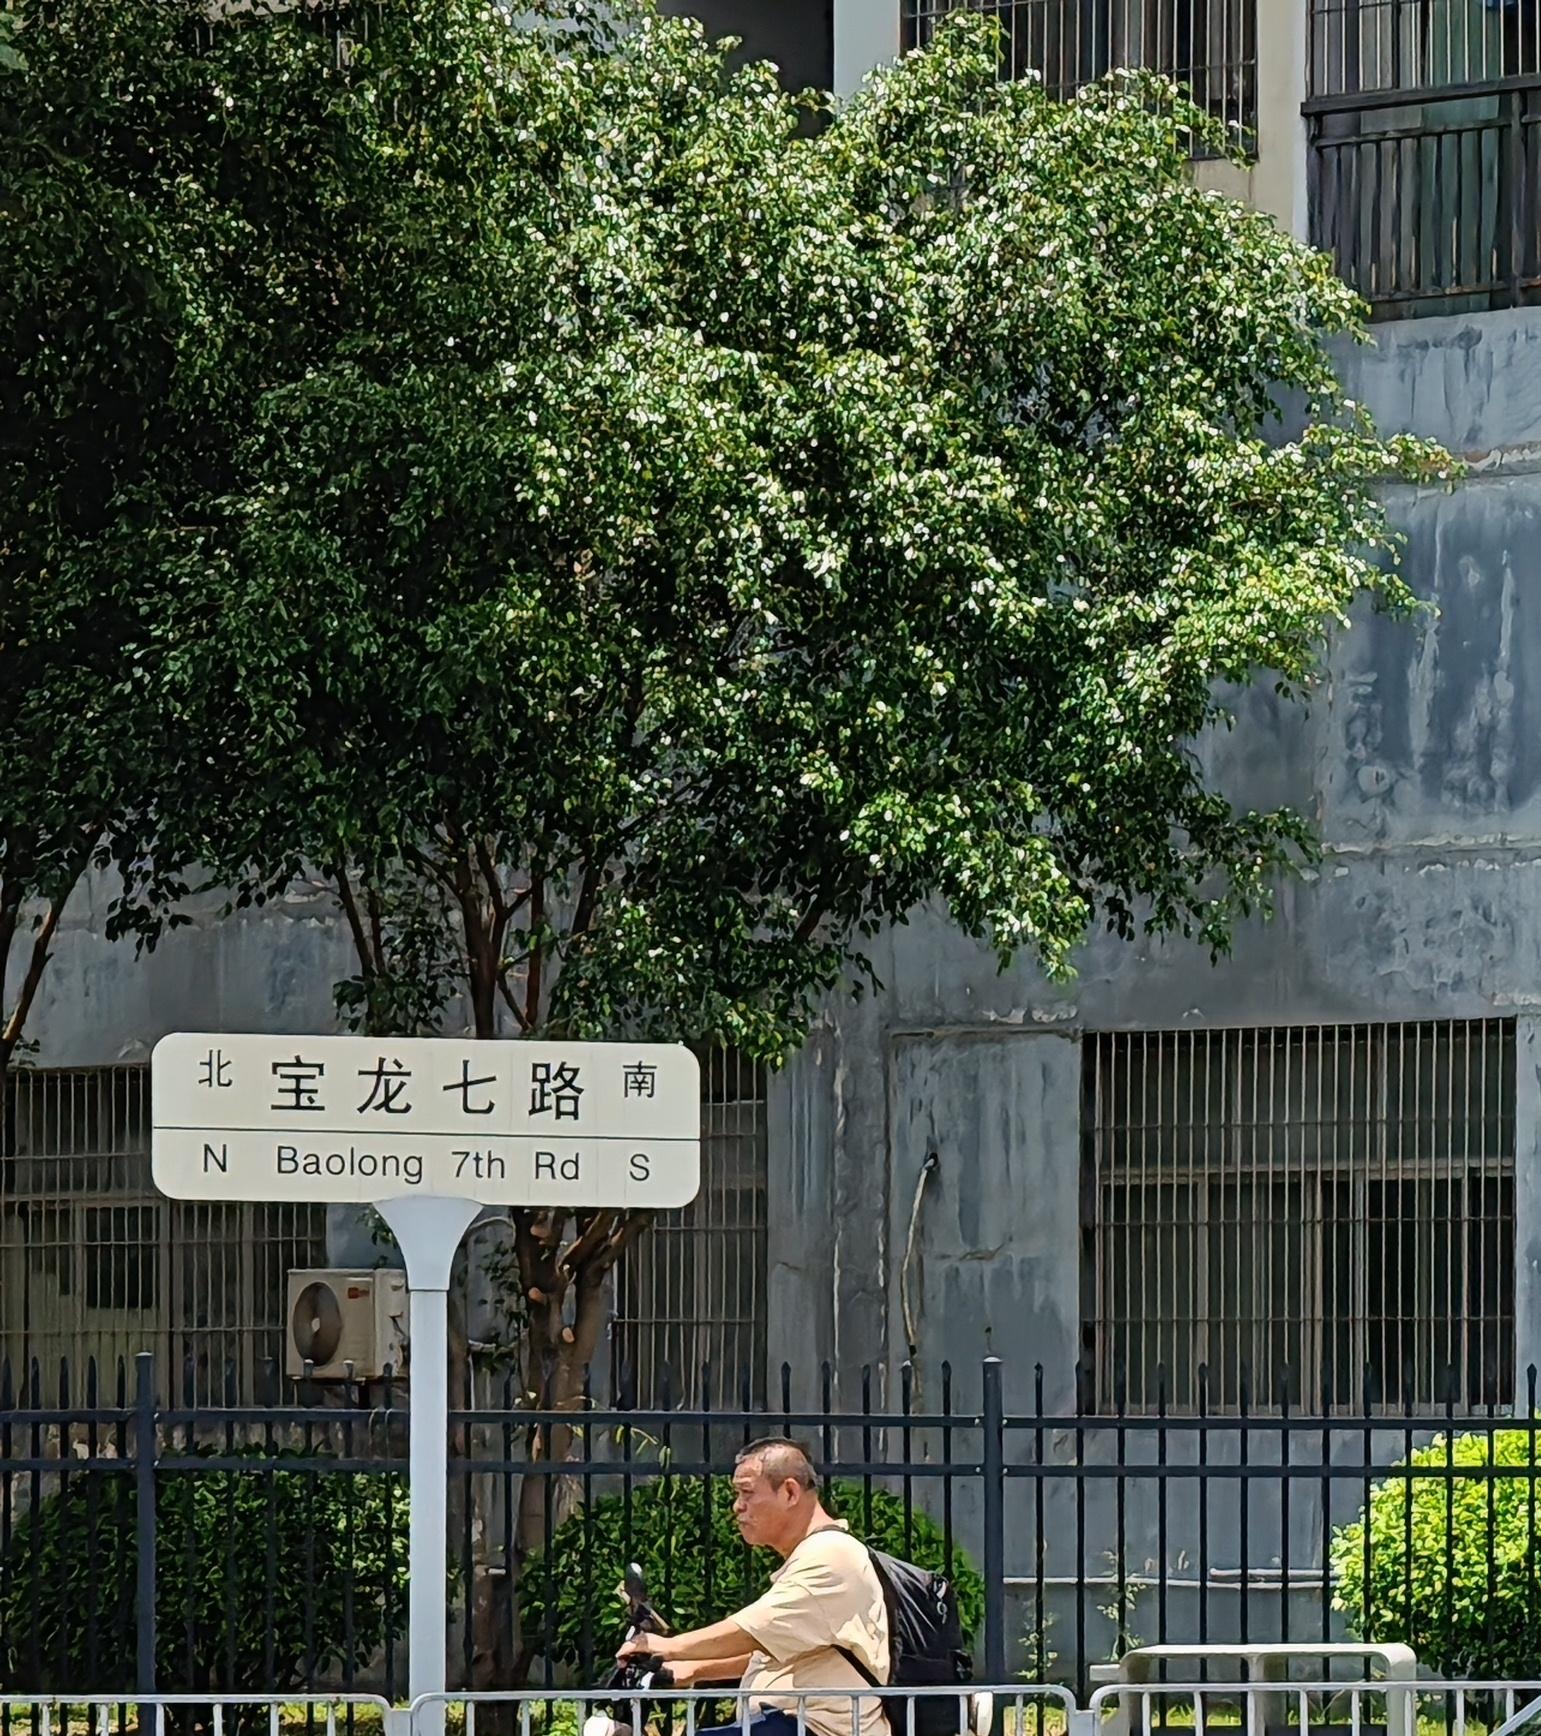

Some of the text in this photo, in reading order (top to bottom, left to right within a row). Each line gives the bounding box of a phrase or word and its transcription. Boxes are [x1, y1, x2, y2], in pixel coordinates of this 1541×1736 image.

[198, 1049, 658, 1121] 北 宝龙七路 南
[203, 1143, 651, 1185] N Baolong 7th Rd S
